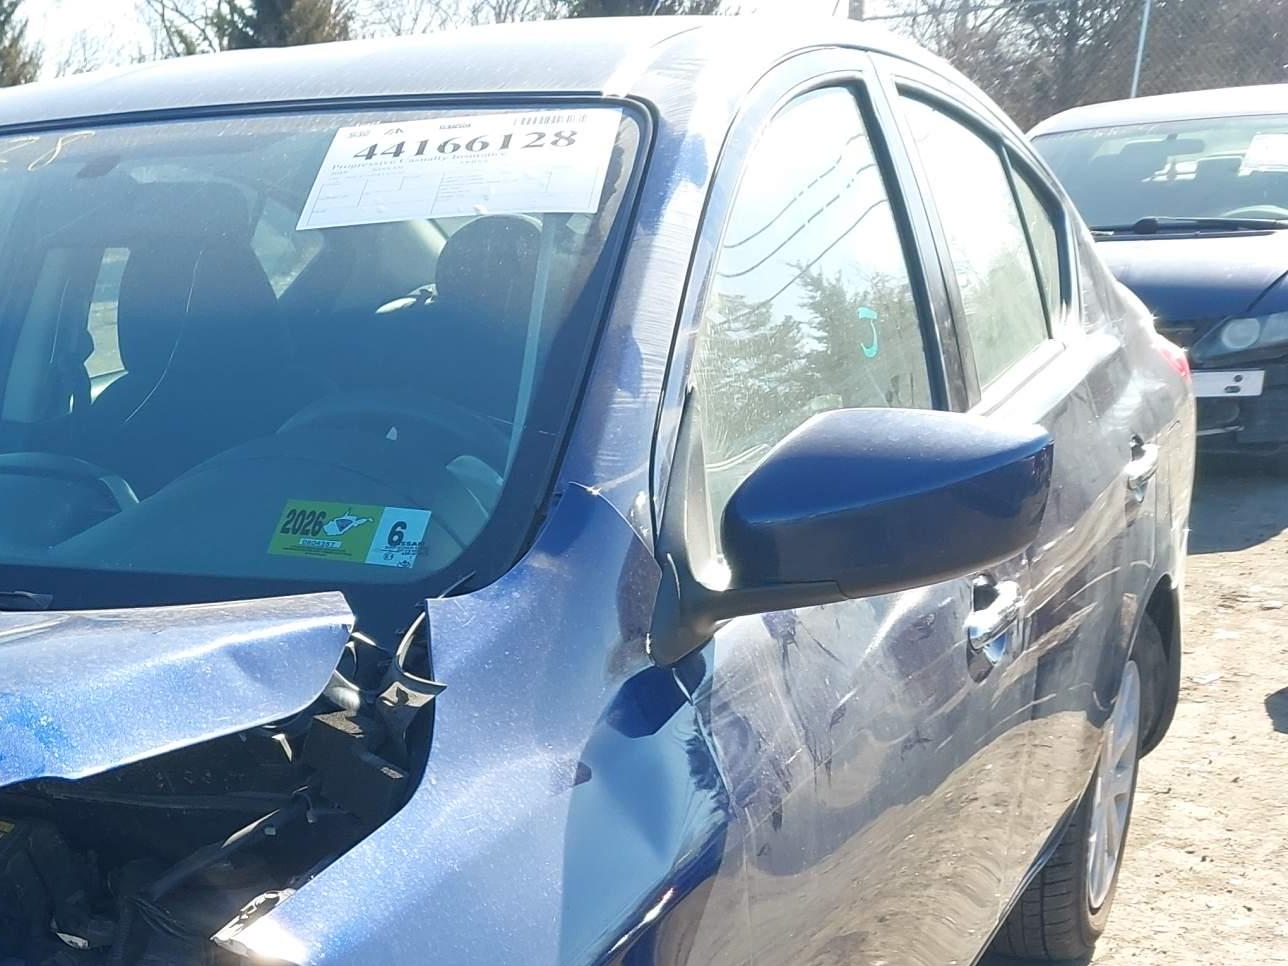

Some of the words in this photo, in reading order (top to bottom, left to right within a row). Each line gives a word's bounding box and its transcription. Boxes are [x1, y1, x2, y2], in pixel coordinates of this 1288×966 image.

[353, 130, 579, 161] 44166128
[280, 508, 327, 537] 2026
[387, 520, 407, 548] 6
